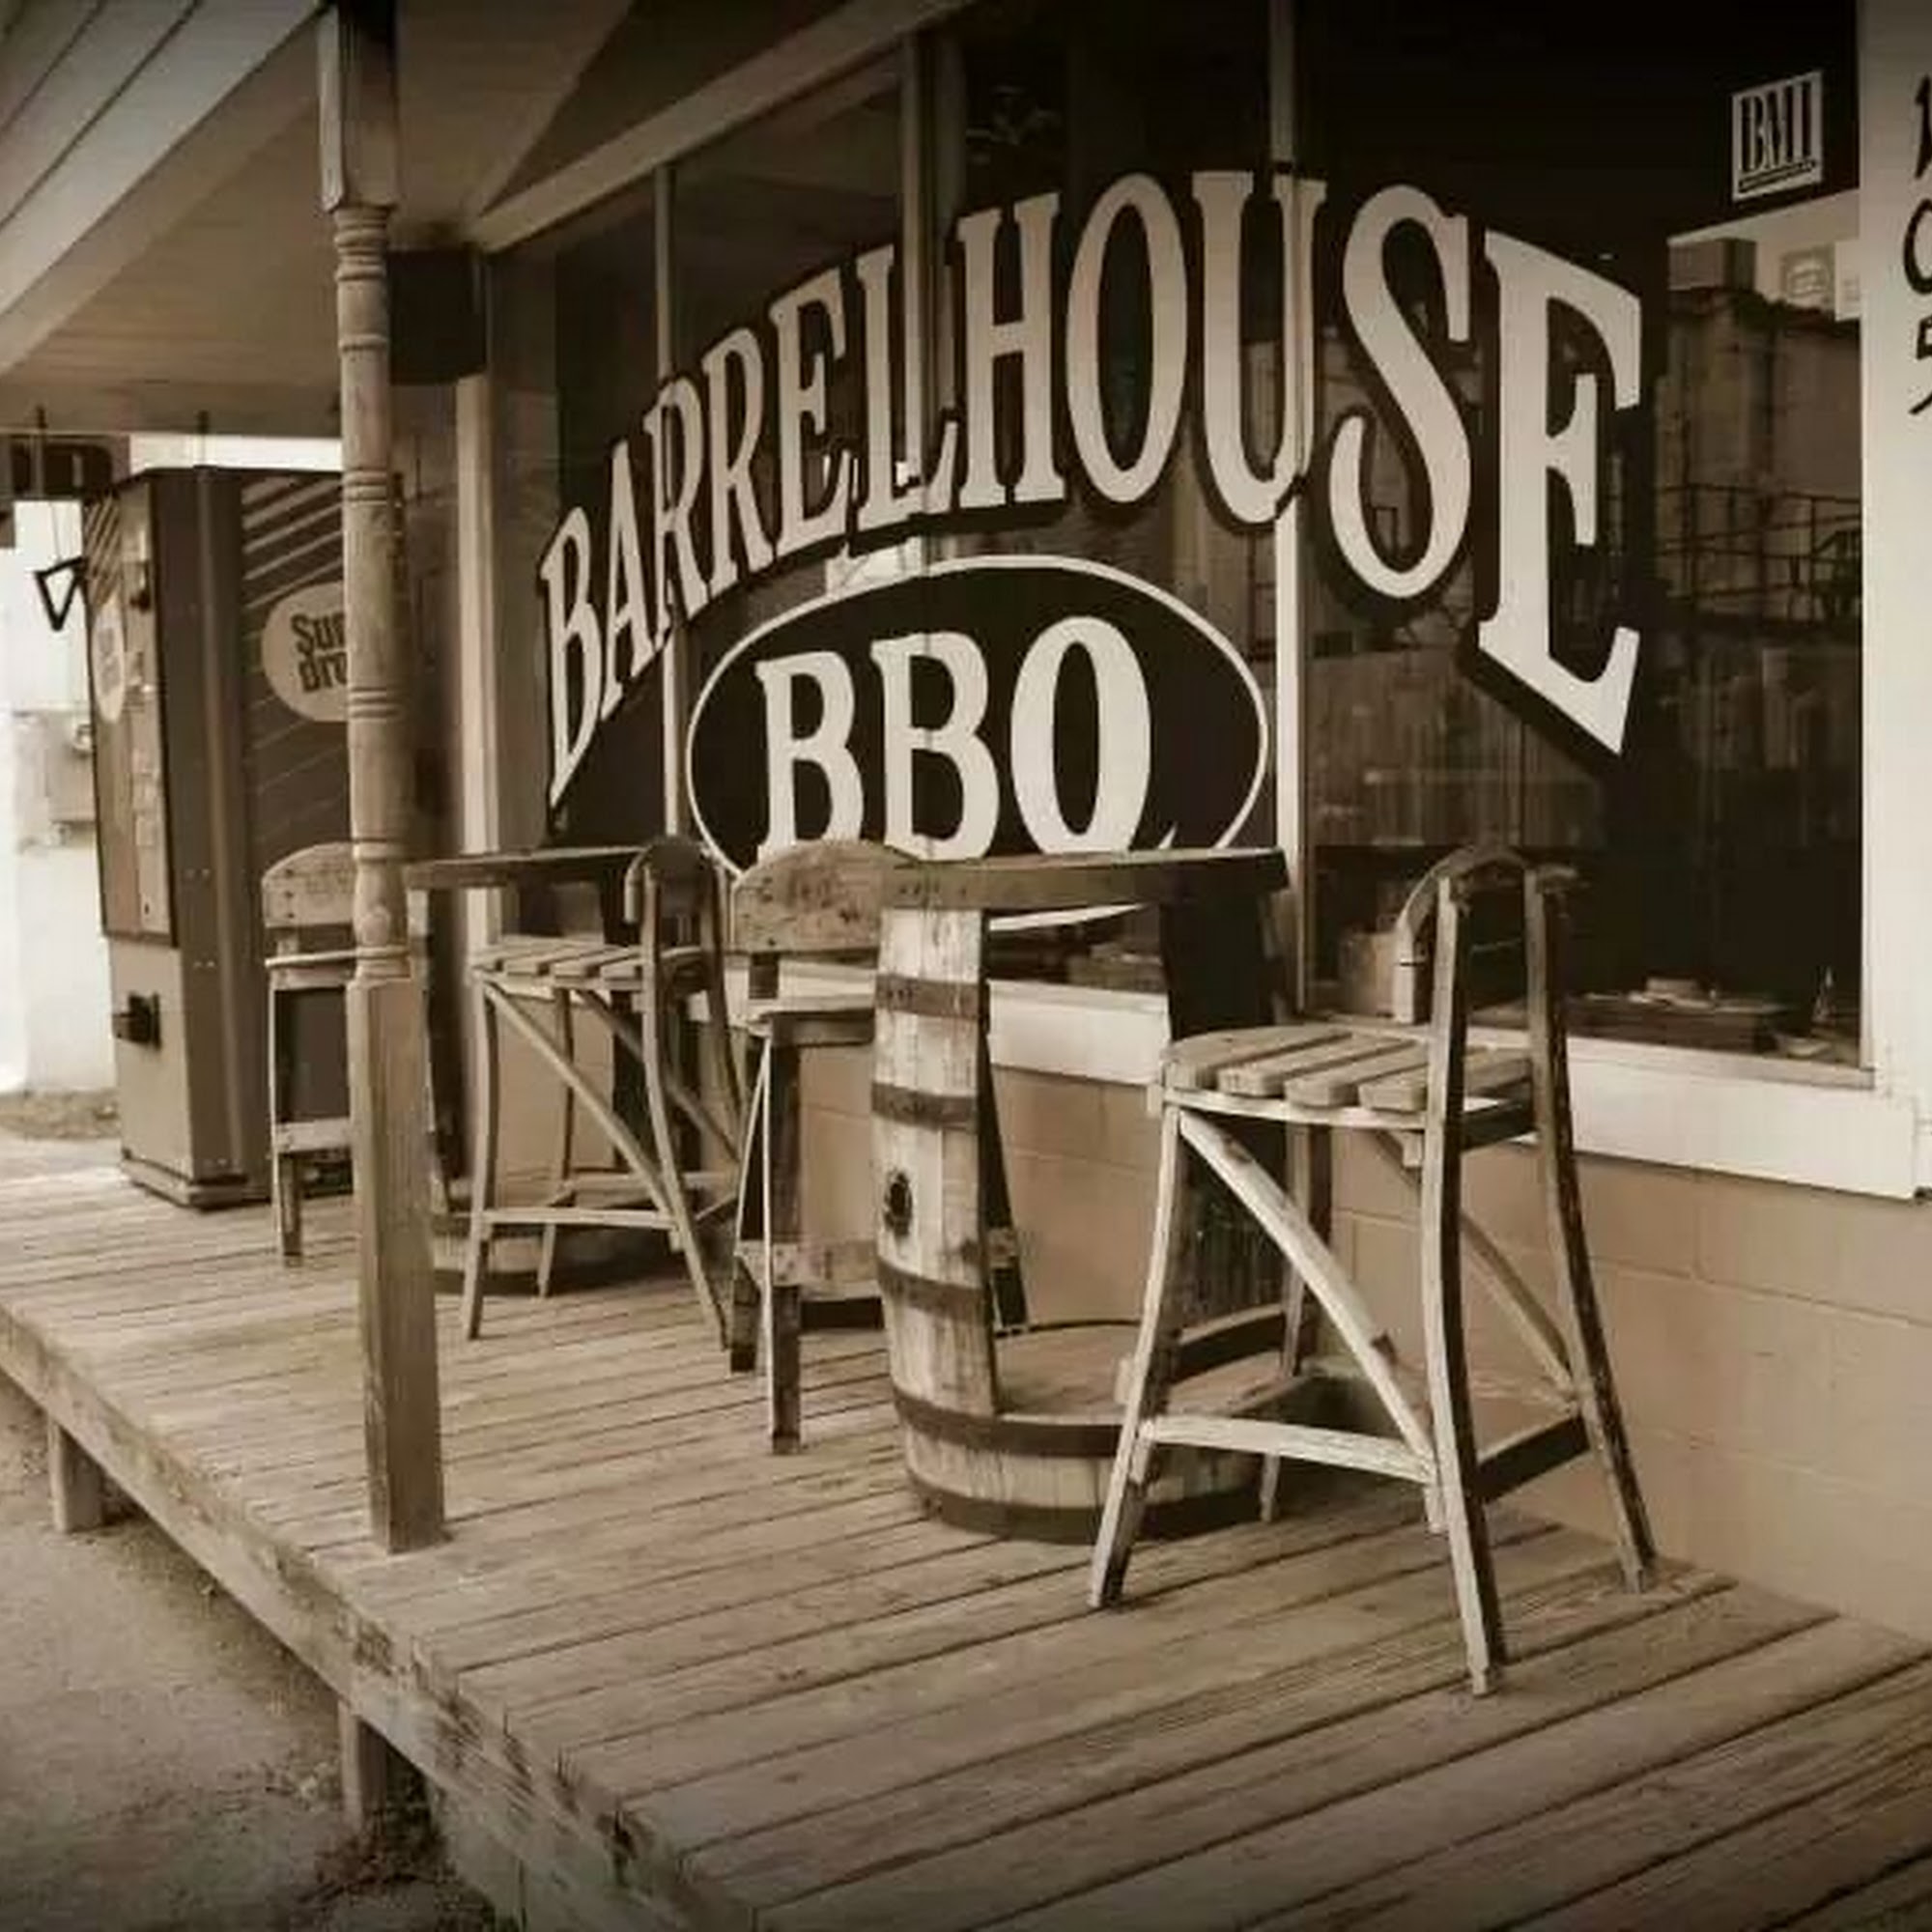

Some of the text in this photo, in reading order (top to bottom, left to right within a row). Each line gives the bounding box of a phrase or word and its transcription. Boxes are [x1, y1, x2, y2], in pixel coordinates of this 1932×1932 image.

[1740, 80, 1812, 174] BMI
[540, 170, 1643, 809] BARRELHOUSE
[298, 650, 348, 694] dro
[753, 615, 1178, 862] BBQ
